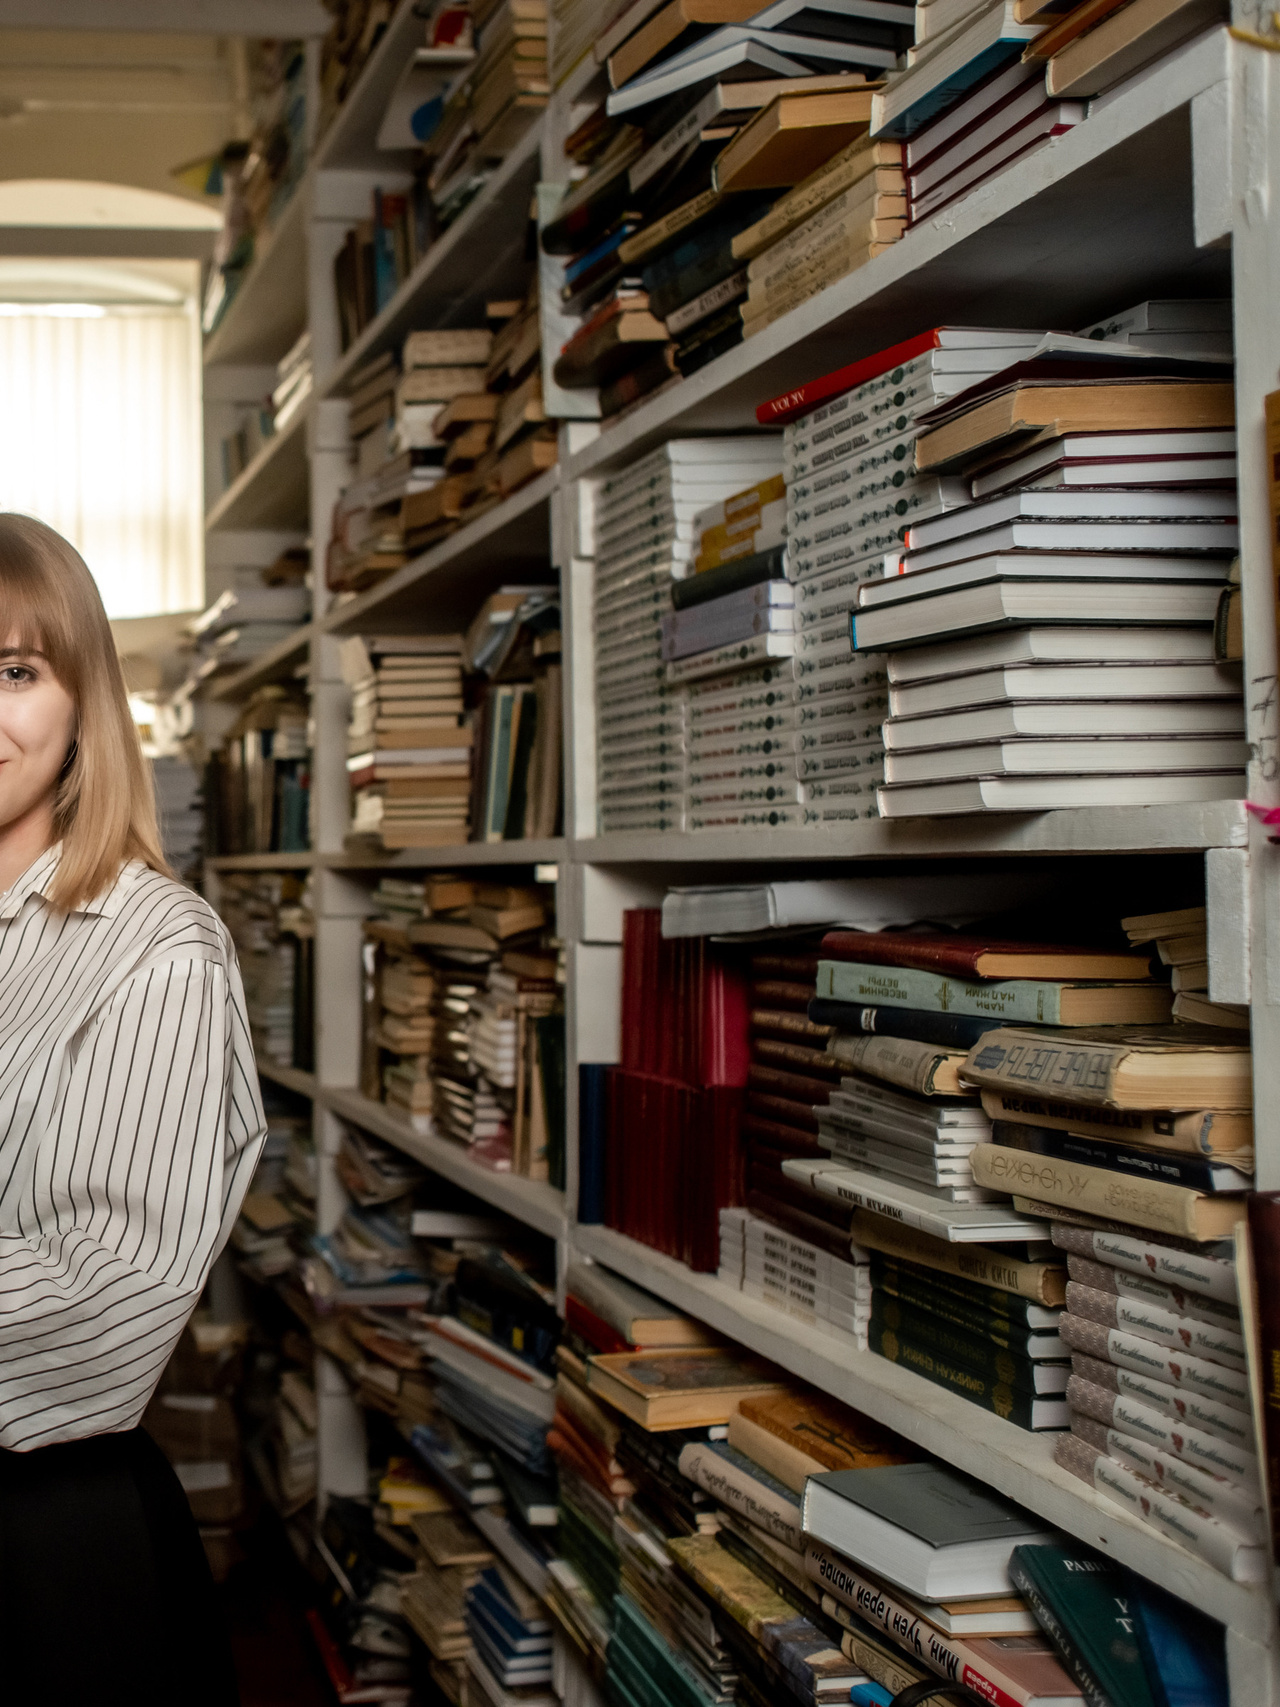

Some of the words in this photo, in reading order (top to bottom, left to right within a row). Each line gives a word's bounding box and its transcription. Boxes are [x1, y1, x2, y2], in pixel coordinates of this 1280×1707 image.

[858, 984, 908, 1000] ВЕСЕННИЕ
[866, 976, 899, 990] ВЕТРЫ
[965, 987, 1016, 1003] НАДЖМИ
[975, 999, 1005, 1012] КАВИ
[903, 1344, 935, 1371] ЕНИКИ
[935, 1363, 986, 1395] ӘМИРХАН
[856, 1582, 891, 1632] Гәрәй
[892, 1611, 924, 1656] Чуен
[927, 1633, 960, 1680] Мин,
[965, 1670, 998, 1701] Гәрәев
